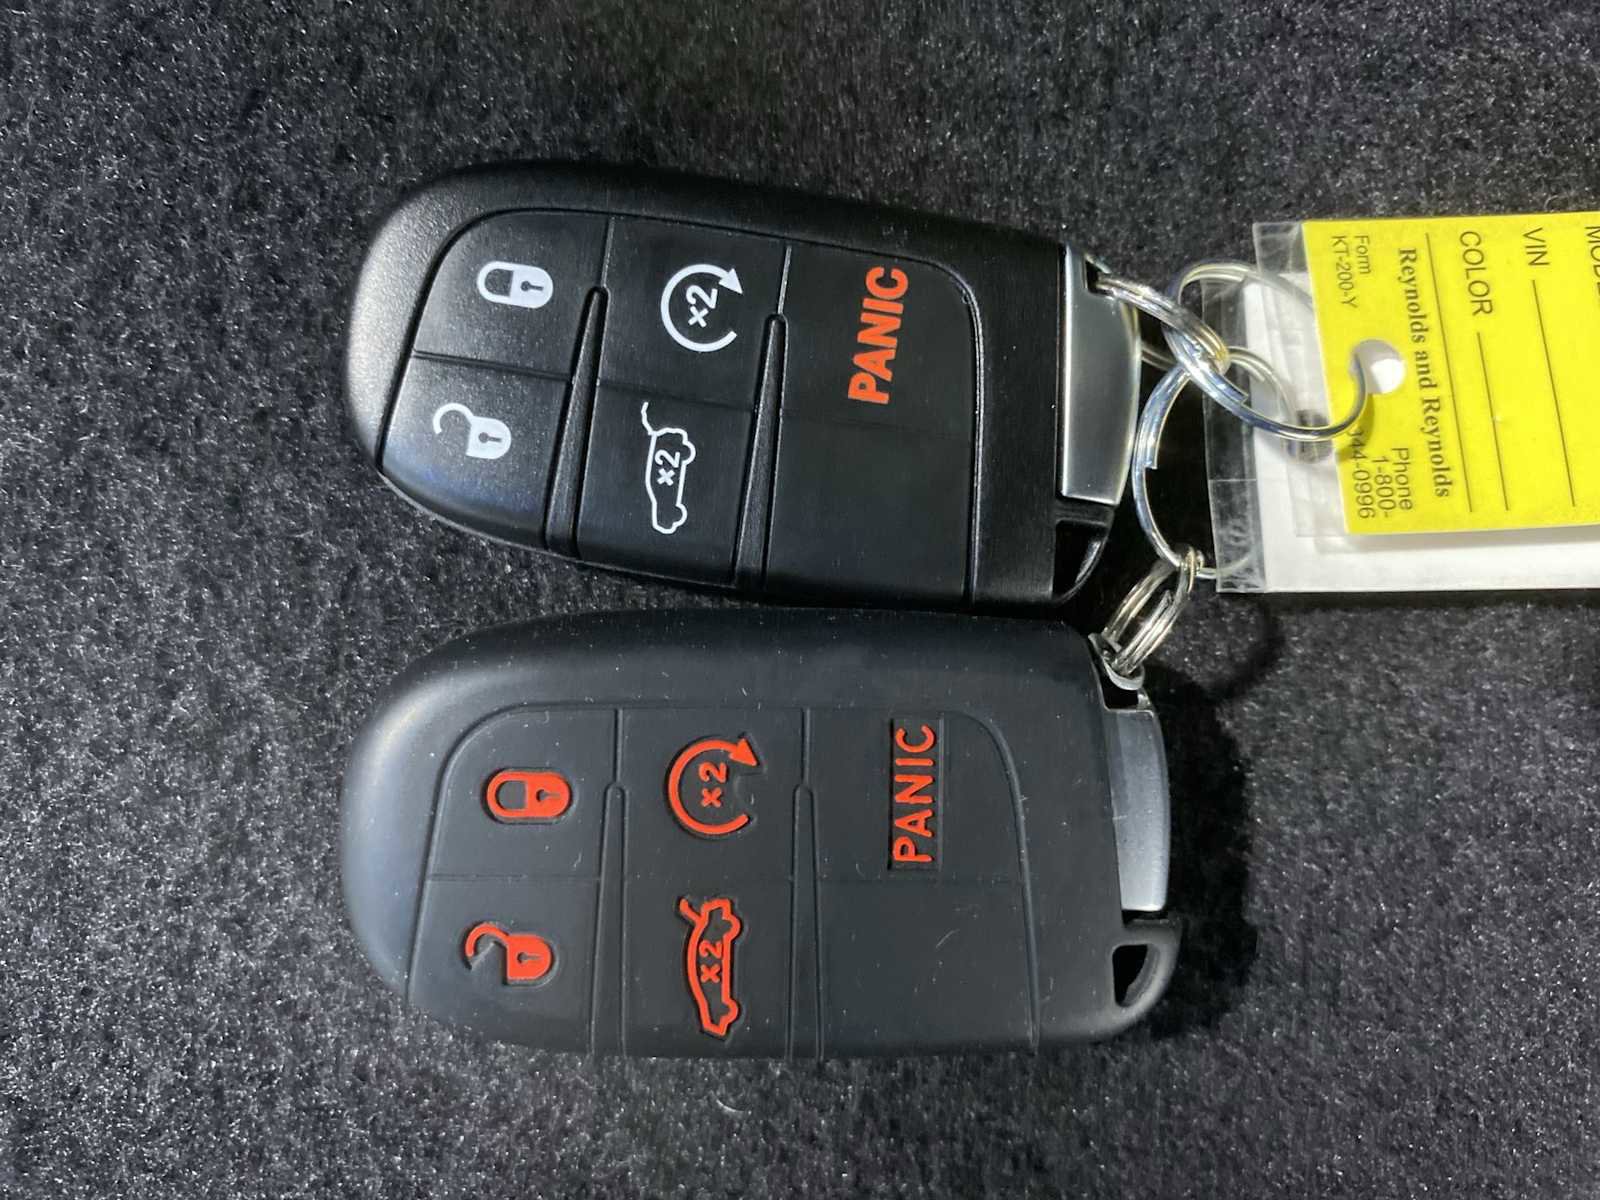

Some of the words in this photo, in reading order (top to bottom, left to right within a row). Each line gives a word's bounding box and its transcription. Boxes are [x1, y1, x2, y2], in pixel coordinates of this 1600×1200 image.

[1332, 235, 1357, 309] KT-200-Y
[1354, 235, 1371, 274] Form
[1459, 230, 1493, 316] COLOR
[1523, 227, 1549, 266] VIN
[1397, 249, 1429, 343] Reynolds
[848, 266, 909, 404] PANIC
[1415, 351, 1438, 389] and
[1391, 447, 1413, 511] Phone
[1421, 397, 1453, 497] Reynolds
[1372, 456, 1396, 518] 1-800-
[892, 724, 936, 863] PANIC
